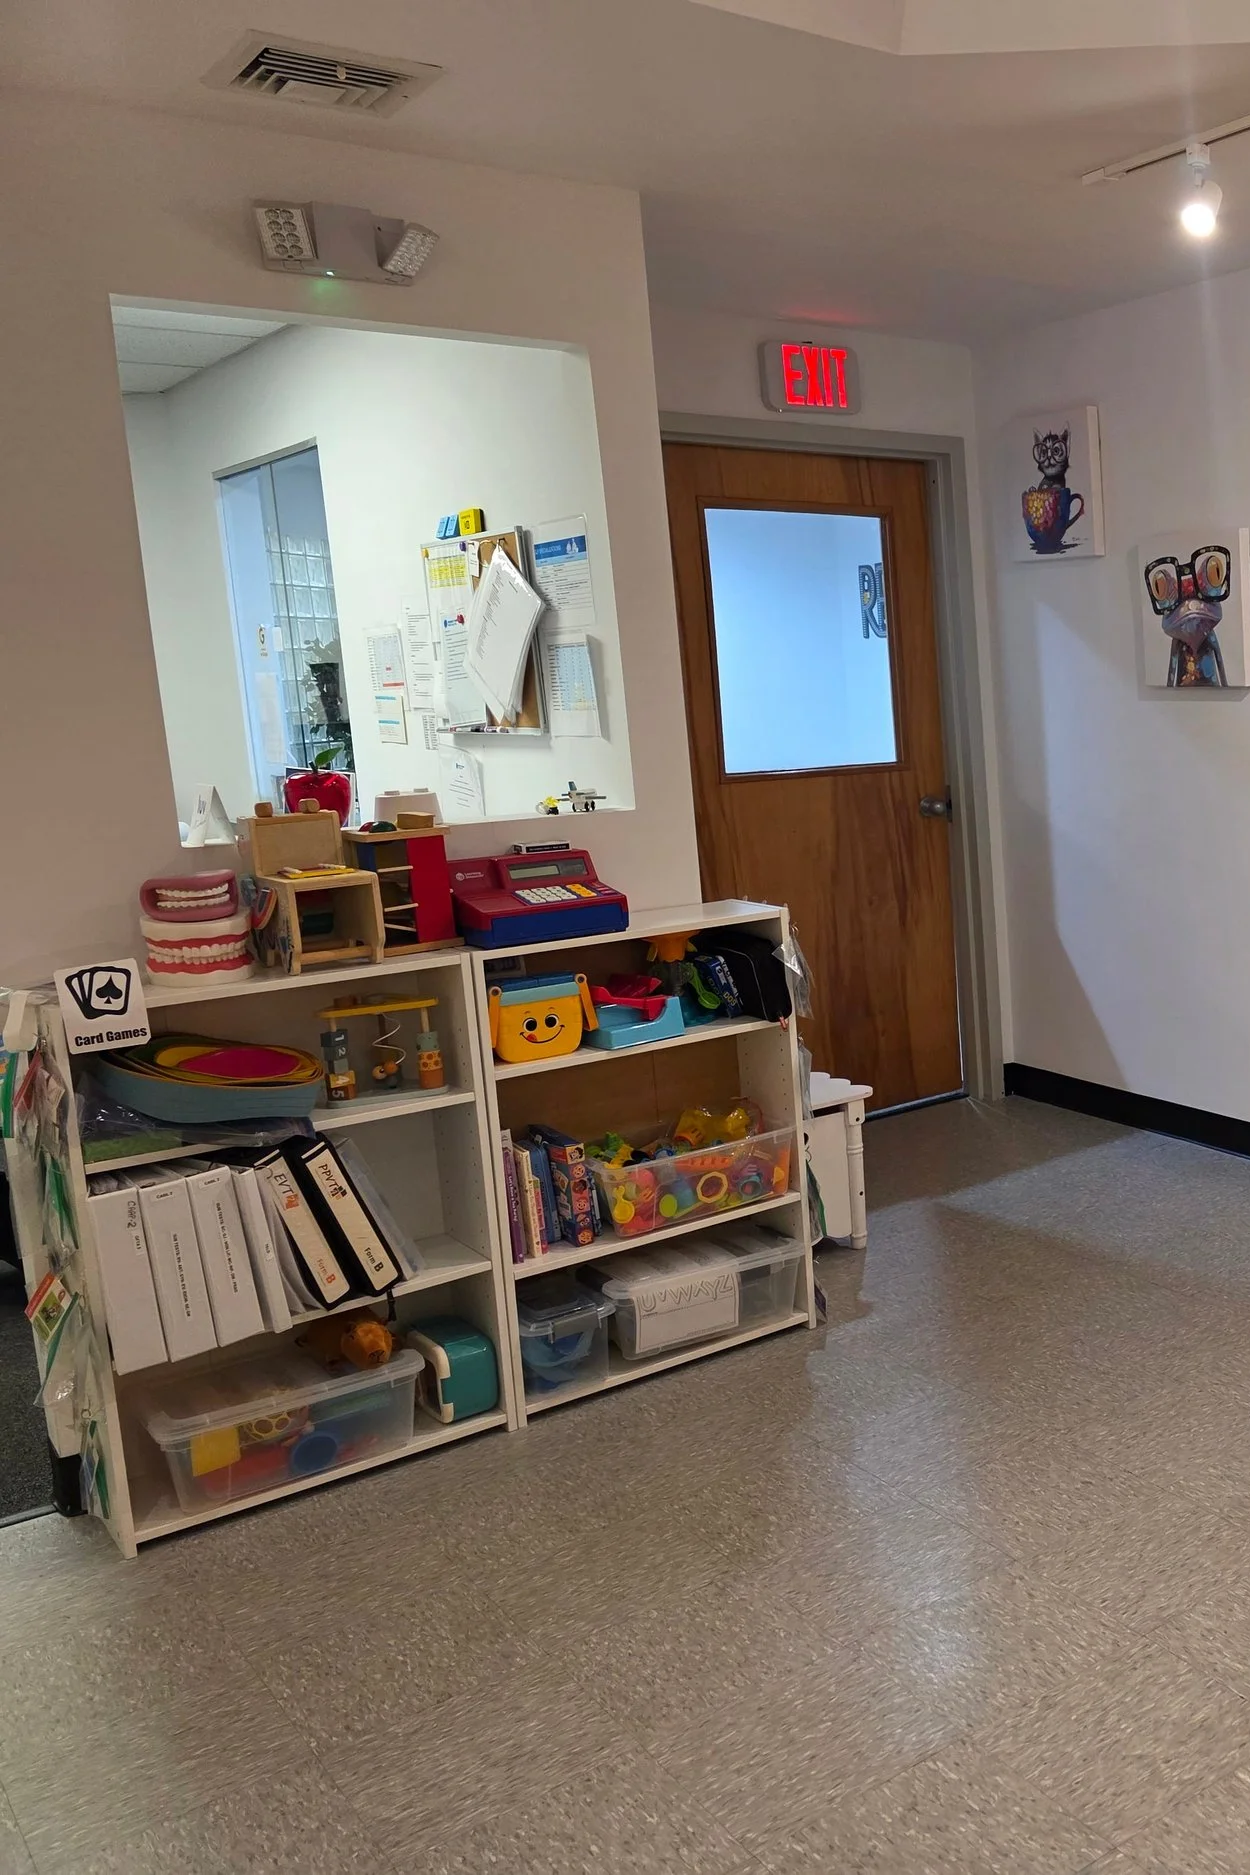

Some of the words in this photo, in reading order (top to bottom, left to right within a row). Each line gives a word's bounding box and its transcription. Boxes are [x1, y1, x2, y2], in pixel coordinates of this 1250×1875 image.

[782, 344, 847, 408] EXIT
[74, 1033, 104, 1047] Card
[106, 1027, 148, 1042] Games
[338, 1047, 346, 1057] 2
[274, 1173, 294, 1194] EVT
[319, 1164, 339, 1188] PPVT
[364, 1247, 376, 1265] Form
[374, 1262, 384, 1272] B
[326, 1274, 336, 1283] B
